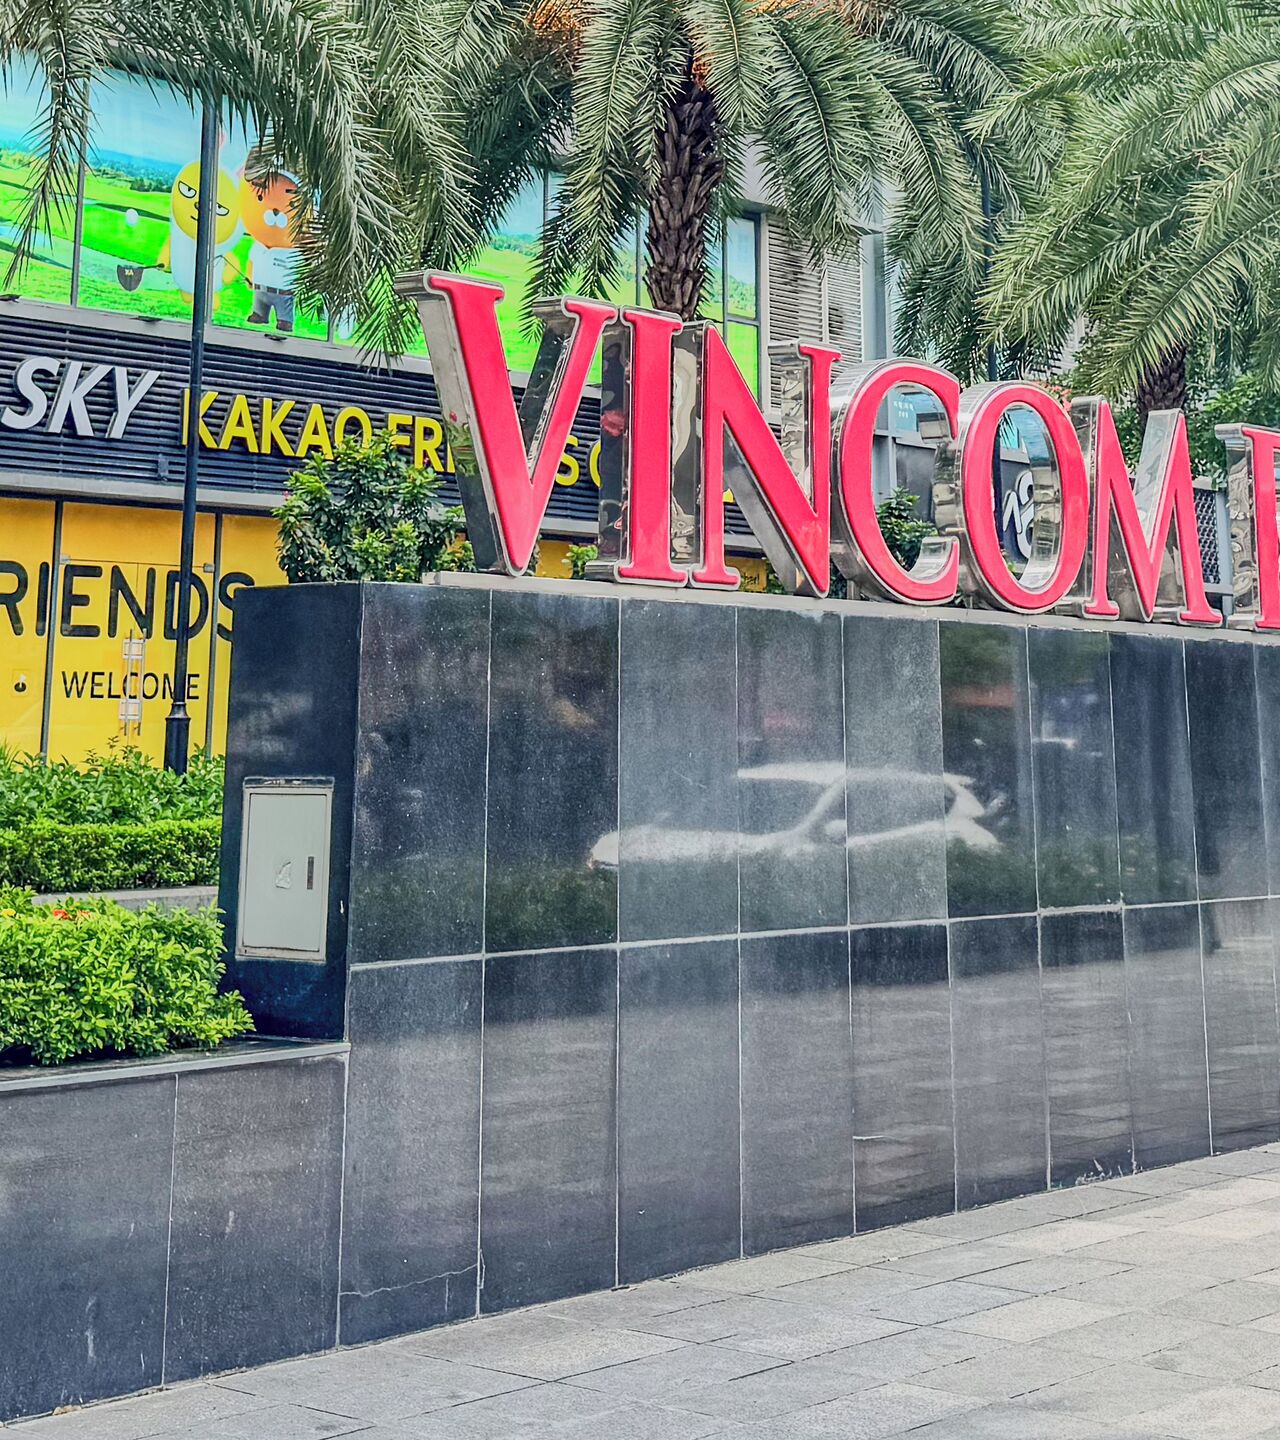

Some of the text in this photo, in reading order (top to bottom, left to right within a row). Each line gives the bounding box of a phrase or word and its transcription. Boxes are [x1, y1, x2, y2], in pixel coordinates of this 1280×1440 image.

[0, 356, 161, 439] SKY
[181, 387, 373, 460] KAKAO
[417, 267, 1223, 626] VINCOM
